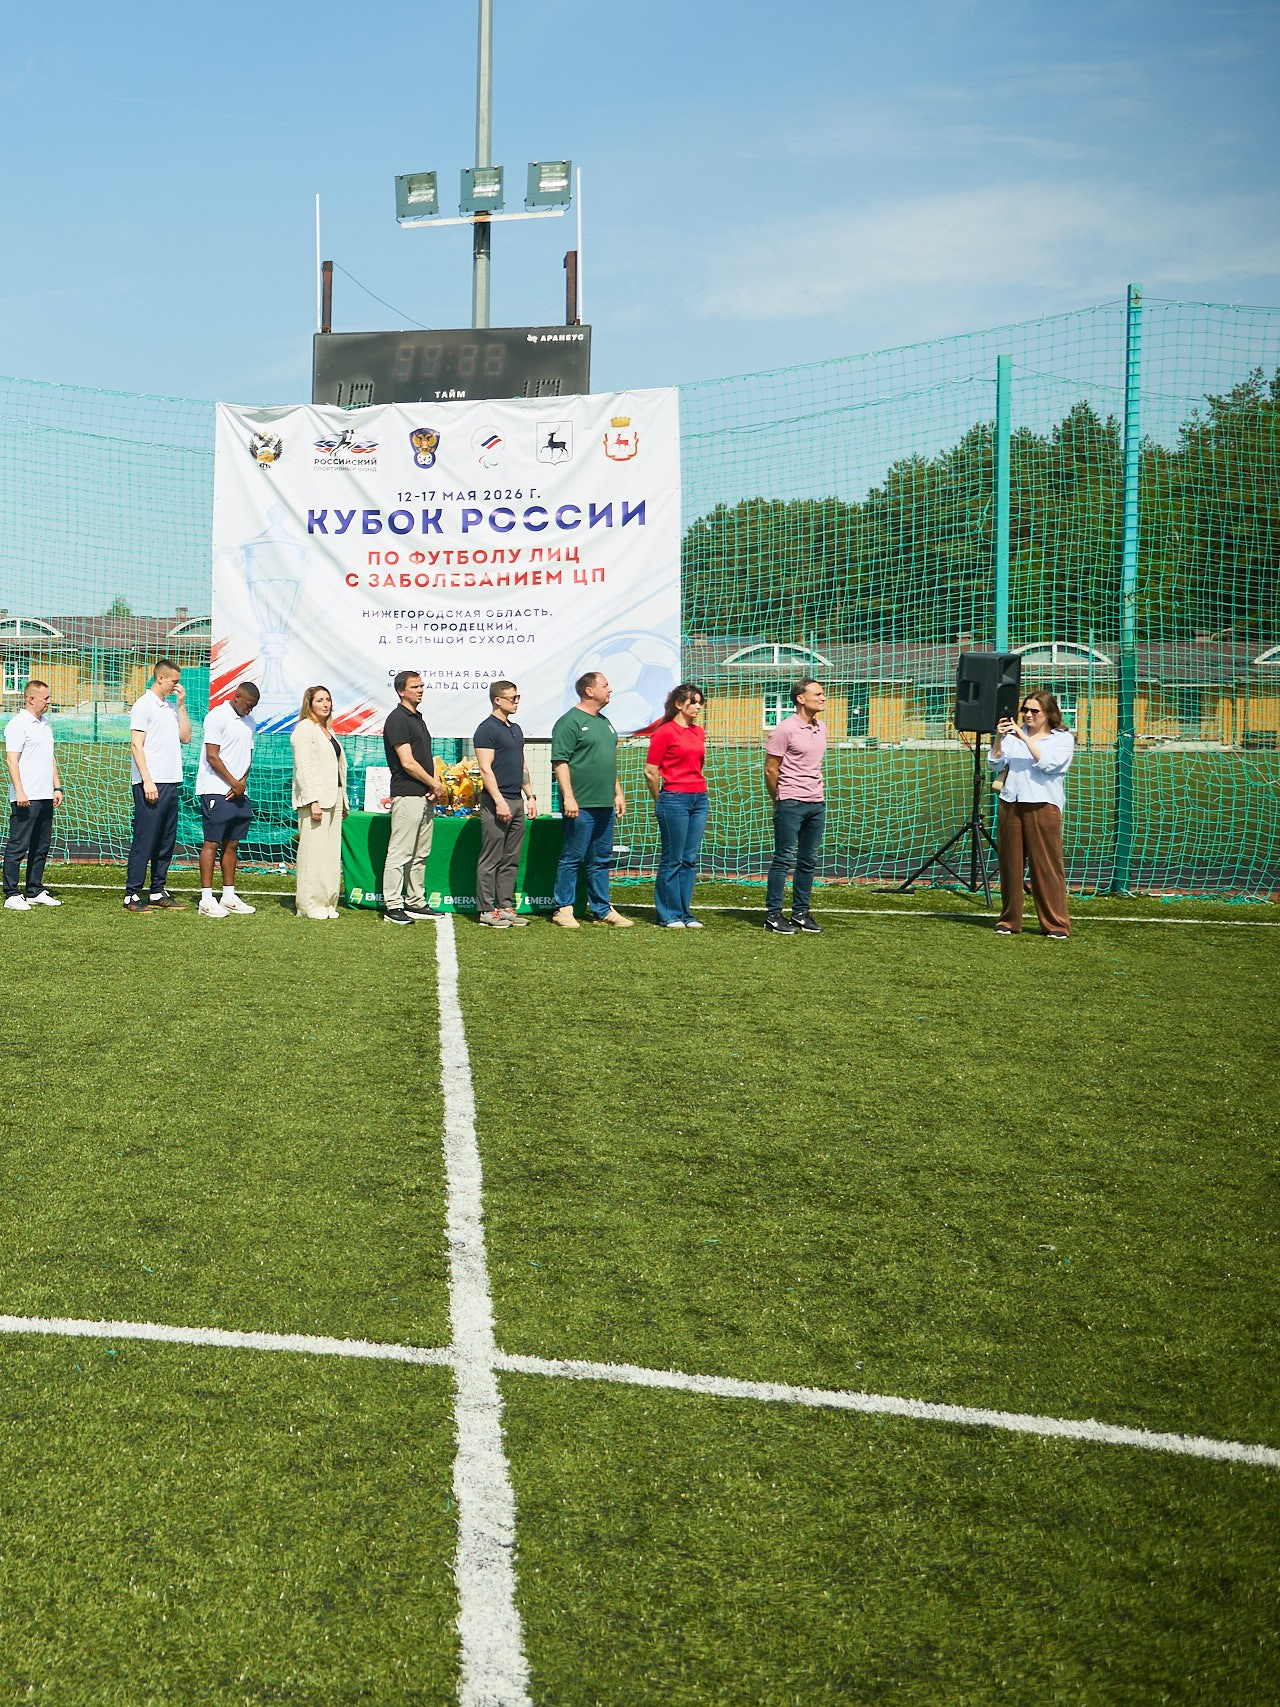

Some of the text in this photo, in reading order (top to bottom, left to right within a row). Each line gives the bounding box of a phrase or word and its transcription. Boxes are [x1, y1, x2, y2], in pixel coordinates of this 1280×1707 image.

[434, 389, 466, 399] ТАЙМ
[314, 457, 377, 466] РОССИЙСКИЙ
[397, 488, 541, 502] 12-17 МАЯ 2026 Г.
[307, 499, 646, 535] КУБОК РОССИИ
[368, 546, 580, 566] ПО ФУТБОЛУ ЛИЦ
[345, 567, 606, 588] С ЗАБОЛЕВАНИЕМ ЦП
[362, 610, 481, 619] НИЖЕГОРОДСКАЯ
[396, 623, 419, 632] Р-Н
[378, 634, 536, 645] Д. БОЛЬШОЙ СУХОДОЛ
[388, 669, 505, 678] СТИВНАЯ БАЗА
[443, 896, 477, 905] EMERA
[524, 896, 557, 905] EMERA
